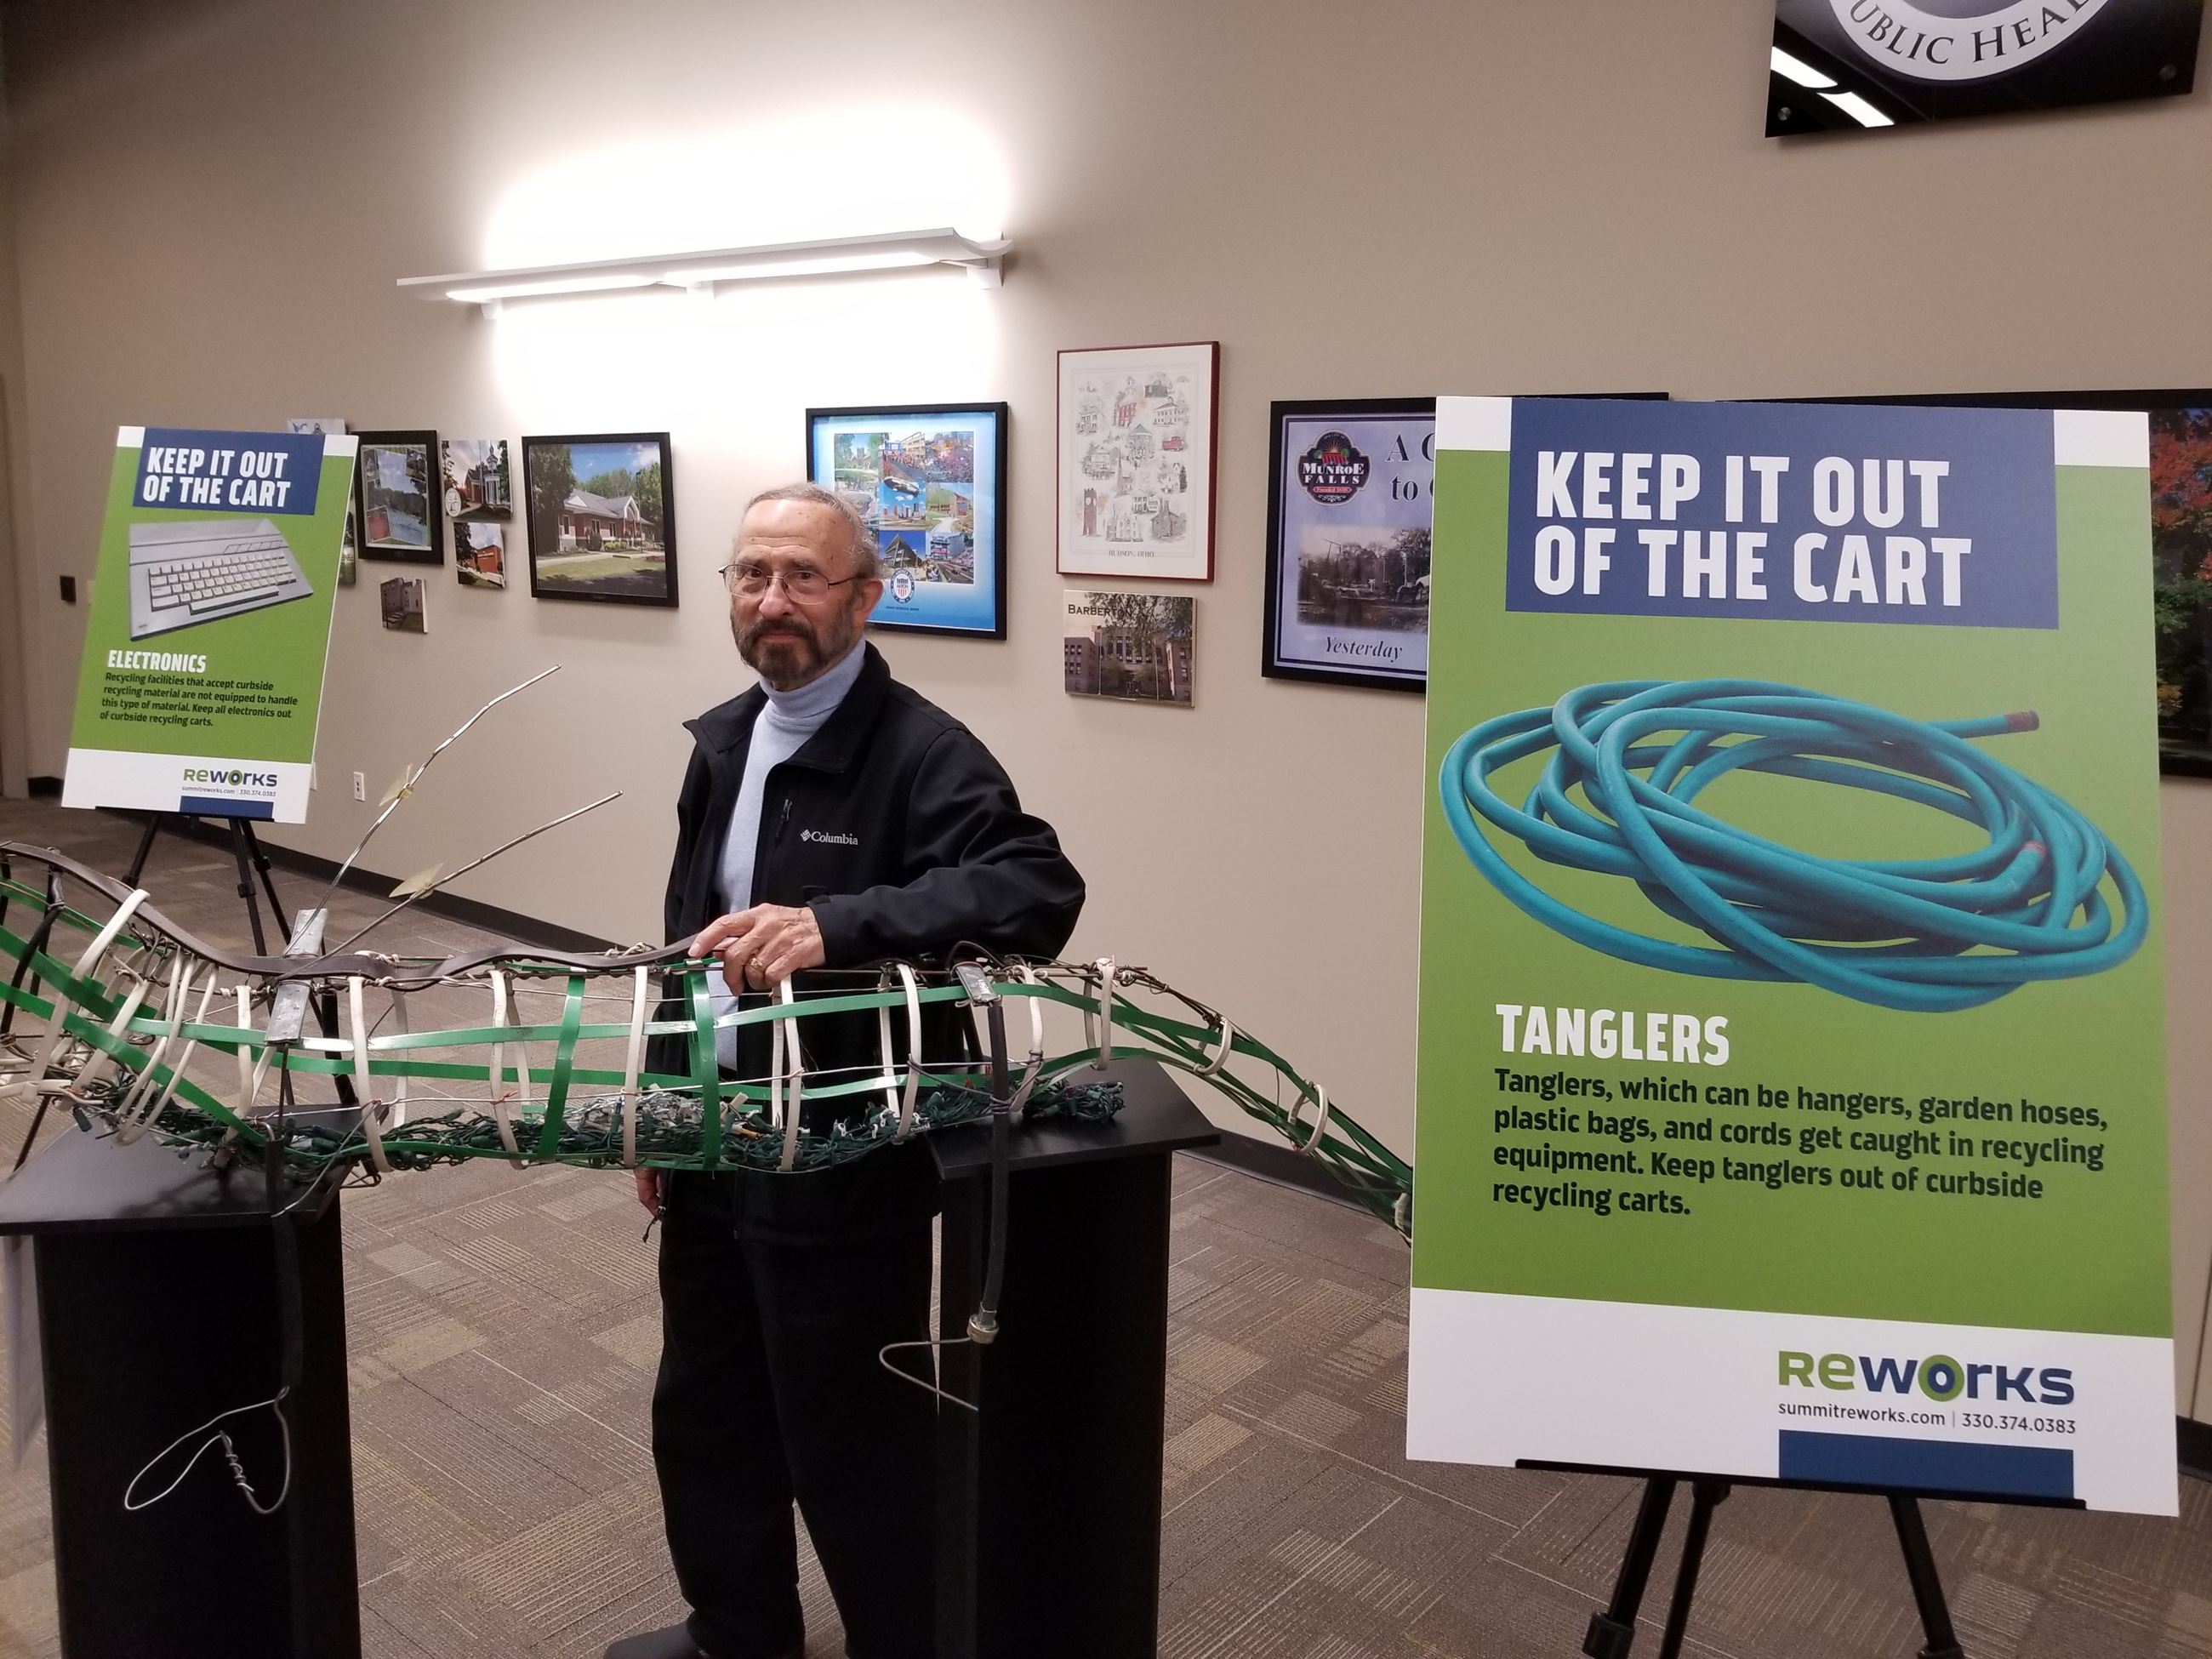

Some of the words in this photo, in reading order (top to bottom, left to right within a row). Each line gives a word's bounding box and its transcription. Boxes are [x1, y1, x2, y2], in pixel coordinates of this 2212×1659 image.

[1850, 0, 1954, 65] UBLIC
[1970, 0, 2089, 63] HEAL
[1385, 433, 1411, 462] A
[146, 447, 205, 475] KEEP
[209, 449, 235, 476] IT
[239, 450, 288, 479] OUT
[1303, 462, 1364, 475] MUNROE
[142, 475, 174, 502] OF
[180, 477, 224, 505] THE
[228, 478, 291, 507] CART
[1304, 475, 1360, 485] FALLS
[1391, 474, 1418, 501] to
[1536, 451, 1701, 521] KEEP
[1725, 454, 1790, 523] IT
[1813, 456, 1950, 528] OUT
[1534, 525, 1616, 596] OF
[1638, 528, 1768, 601] THE
[1793, 533, 1972, 607] CART
[107, 650, 207, 673] ELECTRONICS
[1326, 636, 1402, 663] Yesterday
[104, 686, 141, 698] recycling
[144, 688, 180, 698] material
[182, 691, 196, 699] are
[197, 692, 212, 700] not
[214, 693, 255, 704] equipped
[257, 694, 266, 704] to
[268, 694, 298, 705] handle
[105, 672, 146, 685] Recycling
[147, 674, 185, 686] facilities
[186, 677, 204, 687] that
[206, 680, 234, 690] accept
[236, 681, 274, 691] curbside
[100, 710, 110, 720] of
[111, 711, 147, 722] curbside
[149, 714, 188, 727] recycling
[190, 716, 214, 727] carts.
[101, 698, 118, 708] this
[120, 699, 140, 710] type
[141, 700, 151, 710] of
[151, 701, 191, 713] material.
[192, 704, 214, 715] Keep
[215, 704, 225, 714] all
[227, 705, 275, 717] electronics
[276, 709, 292, 718] out
[182, 786, 235, 795] summitreworks.com
[812, 831, 858, 845] Columbia
[1496, 1003, 1730, 1066] TANGLERS
[1495, 1068, 1612, 1102] Tanglers,
[1619, 1076, 1697, 1103] which
[1705, 1084, 1749, 1106] can
[1758, 1084, 1789, 1109] be
[1797, 1086, 1913, 1120] hangers,
[1918, 1096, 2013, 1124] garden
[2021, 1099, 2108, 1132] hoses,
[1495, 1105, 1580, 1133] plastic
[1588, 1110, 1657, 1143] bags,
[1663, 1117, 1713, 1142] and
[1720, 1121, 1792, 1146] cords
[1799, 1126, 1843, 1154] get
[1850, 1130, 1941, 1160] caught
[1948, 1131, 1974, 1157] in
[1981, 1137, 2104, 1172] recycling
[1493, 1143, 1644, 1174] equipment.
[1651, 1151, 1715, 1183] Keep
[1723, 1156, 1833, 1189] tanglers
[1840, 1166, 1884, 1189] out
[1891, 1166, 1918, 1191] of
[1926, 1171, 2044, 1199] curbside
[1493, 1182, 1612, 1217] recycling
[1618, 1189, 1691, 1215] carts.
[1778, 1402, 1946, 1426] summitreworks.com
[1962, 1412, 2077, 1434] 330.374.0383
